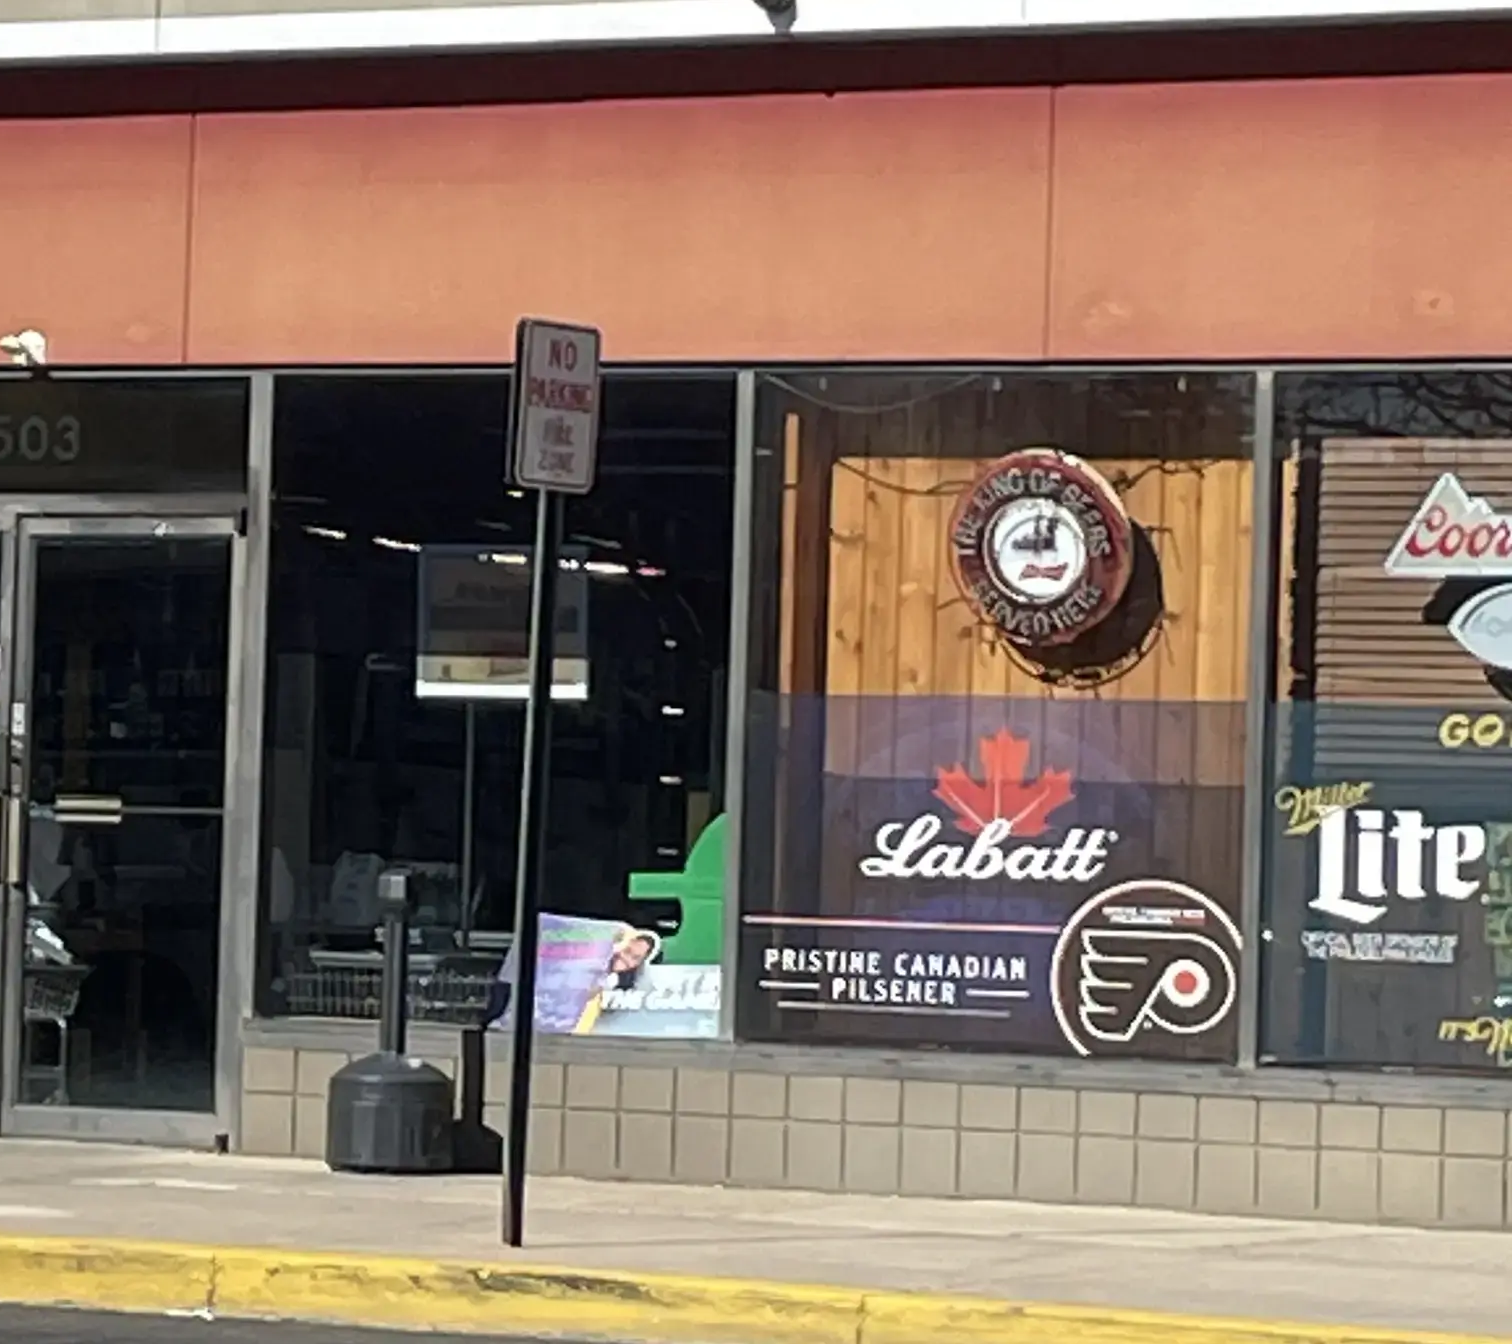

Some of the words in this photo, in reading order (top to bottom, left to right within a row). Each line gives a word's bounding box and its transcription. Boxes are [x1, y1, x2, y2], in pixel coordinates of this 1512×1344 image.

[548, 338, 578, 372] NO
[953, 518, 982, 557] THE
[973, 467, 1026, 510] KING
[1027, 468, 1063, 494] OF
[1059, 483, 1112, 558] BEERS
[972, 580, 1051, 636] SERVED
[1439, 712, 1504, 749] GO
[1274, 781, 1375, 829] Miller
[859, 813, 1108, 882] Labatt
[1308, 805, 1486, 924] Lite
[763, 946, 882, 976] PRISTINE
[893, 954, 1028, 982] CANADIAN
[830, 977, 957, 1006] PILSENER
